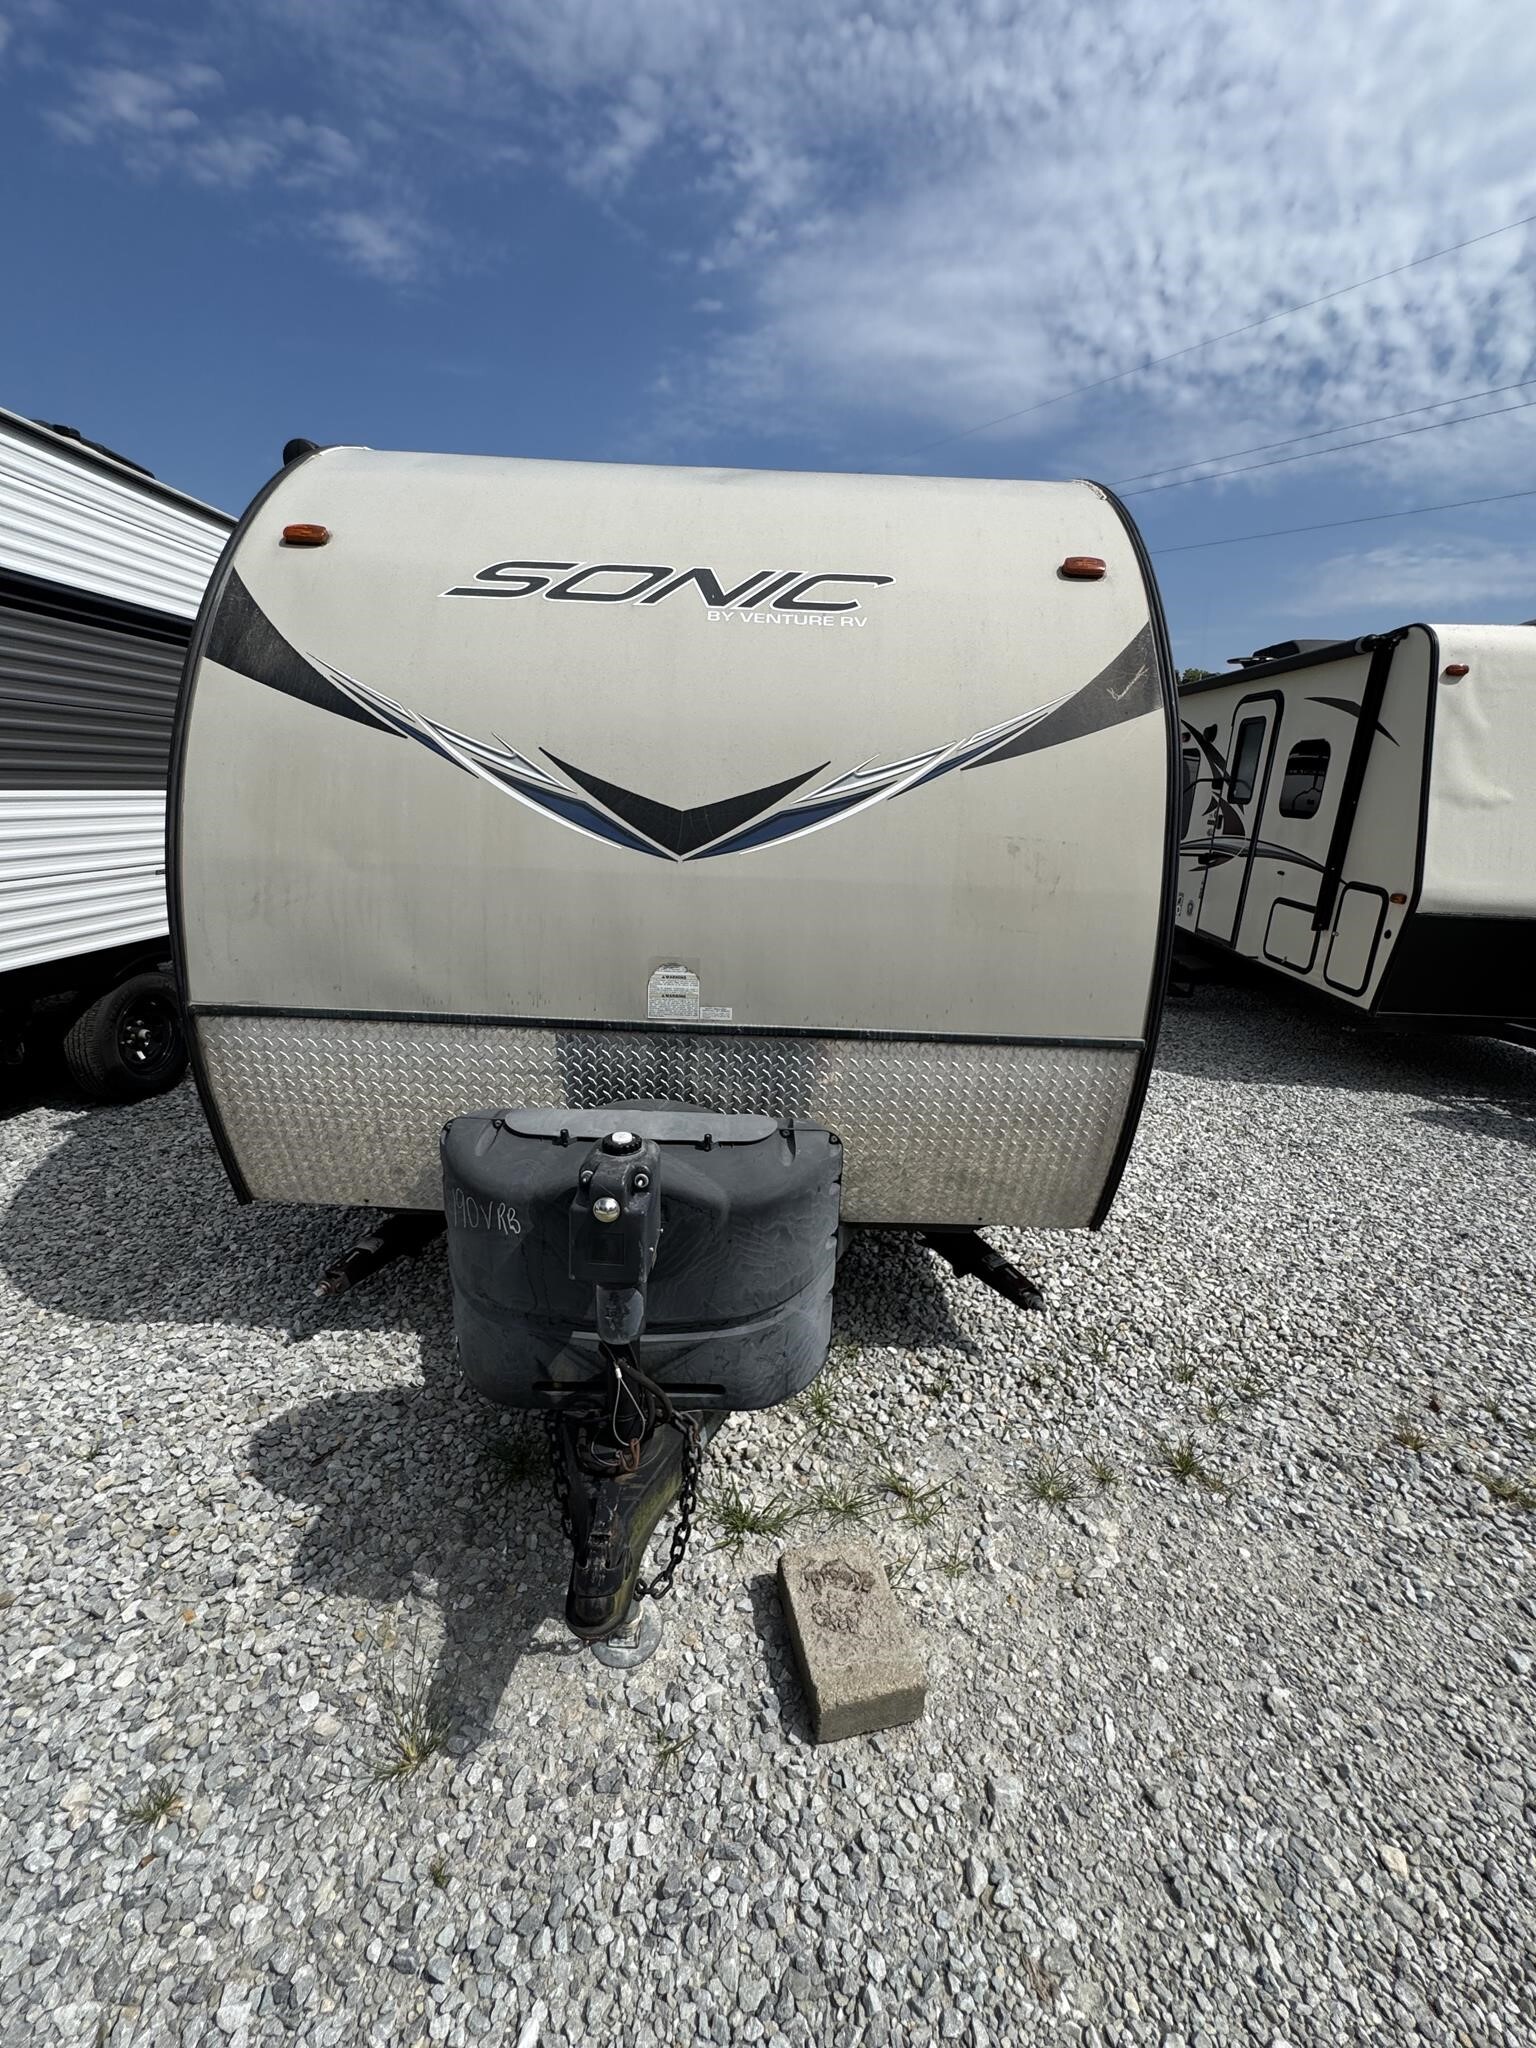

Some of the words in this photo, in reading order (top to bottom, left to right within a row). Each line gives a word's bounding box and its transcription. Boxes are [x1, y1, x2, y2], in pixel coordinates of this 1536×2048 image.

[439, 560, 896, 612] SONIC
[707, 610, 733, 623] BY
[740, 611, 835, 626] VENTURE
[841, 614, 868, 627] RV
